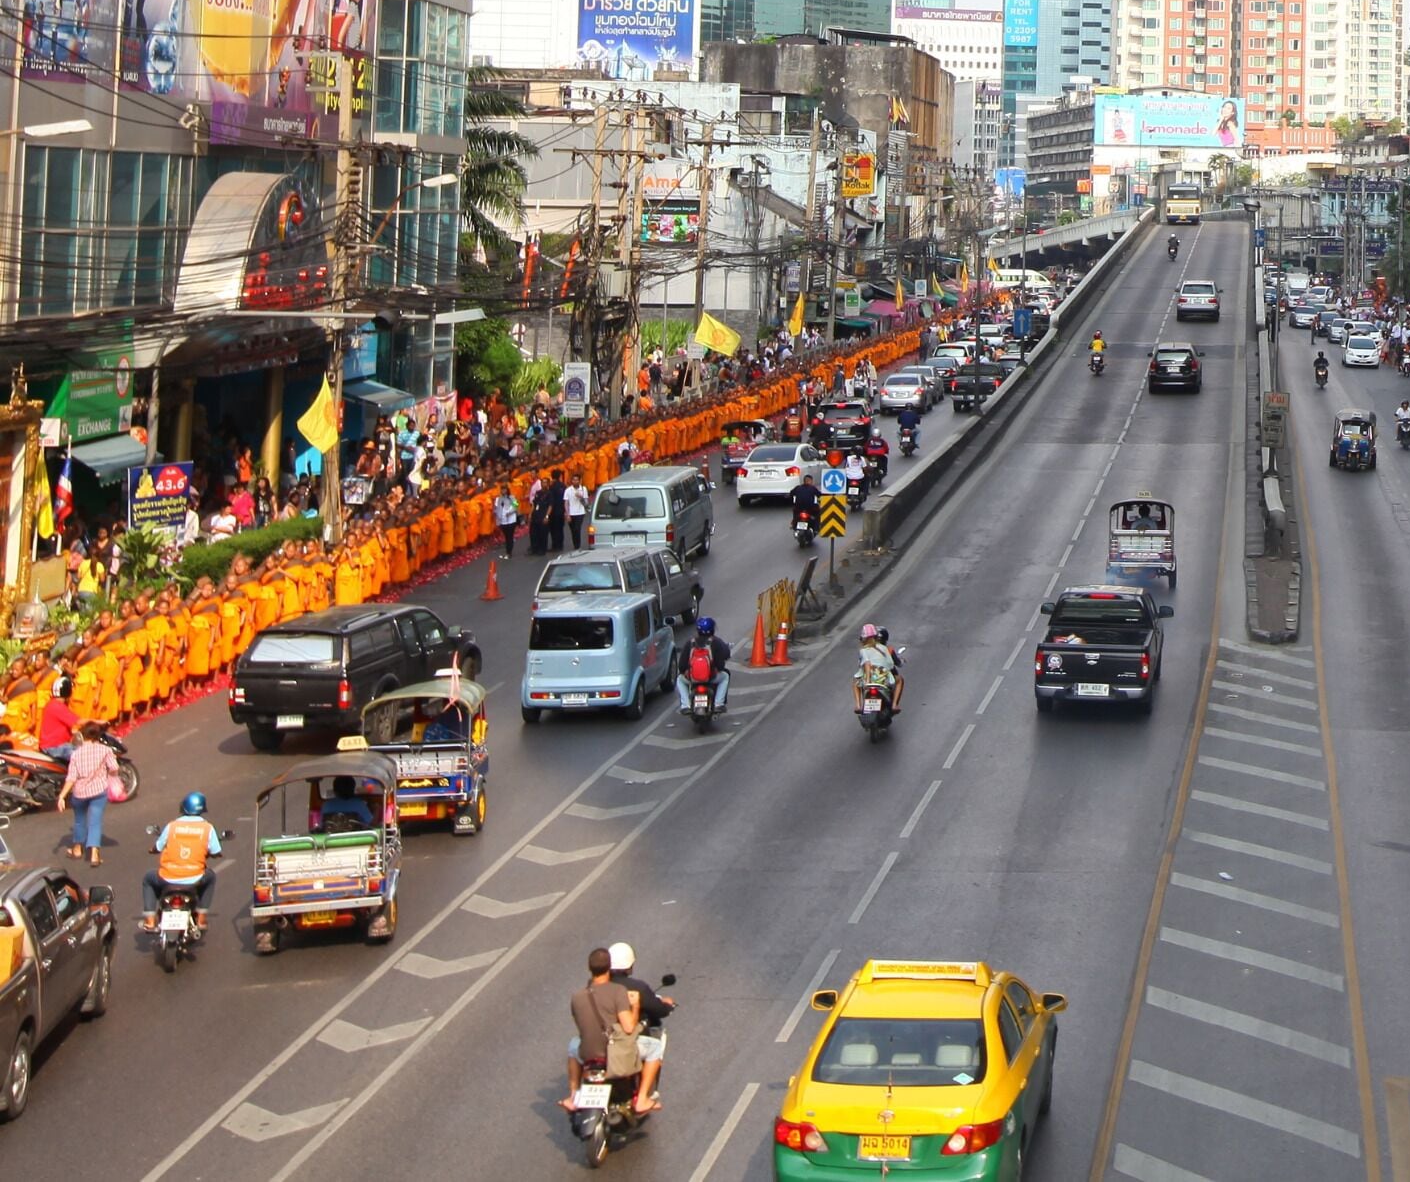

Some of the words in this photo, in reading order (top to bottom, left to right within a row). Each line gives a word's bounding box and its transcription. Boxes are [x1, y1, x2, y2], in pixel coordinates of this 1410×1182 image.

[78, 418, 112, 436] EXCHANGE
[156, 477, 185, 491] 43.6
[342, 738, 362, 747] TAXI
[882, 1137, 908, 1149] 5014
